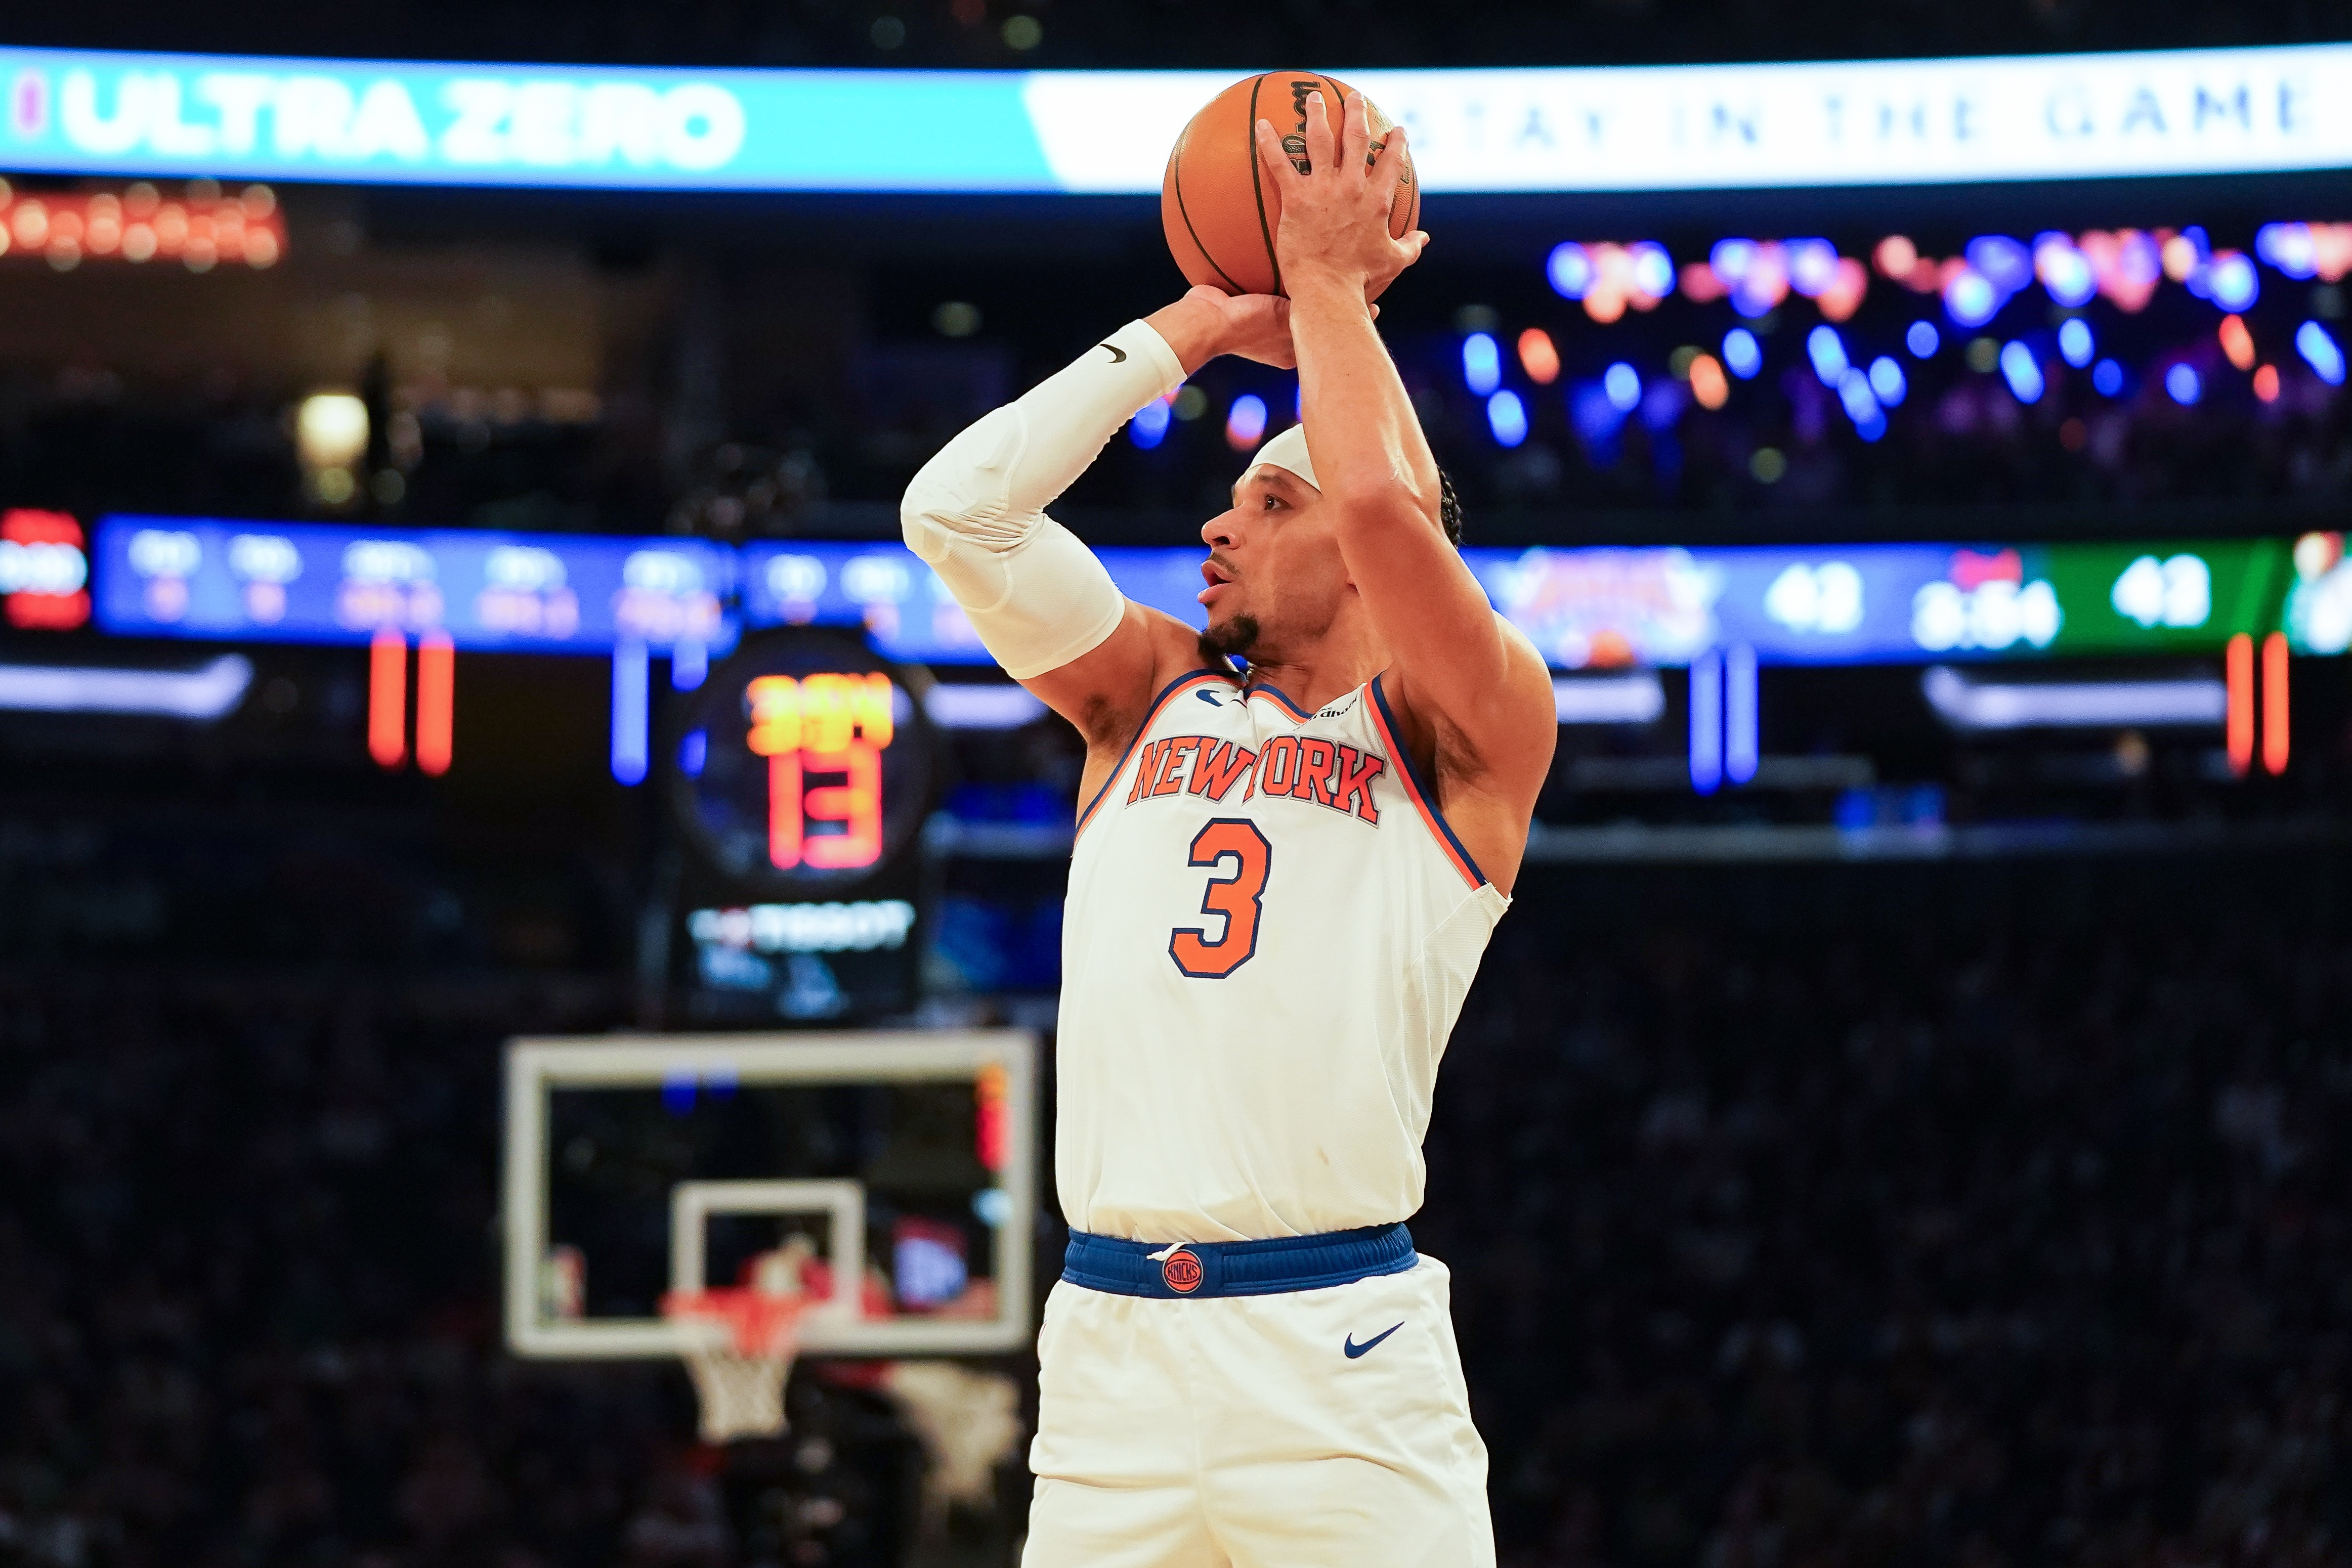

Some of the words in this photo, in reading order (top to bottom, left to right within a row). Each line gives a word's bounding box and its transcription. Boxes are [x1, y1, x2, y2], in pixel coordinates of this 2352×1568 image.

[60, 66, 433, 160] ULTRA
[438, 76, 749, 171] ZERO
[1402, 100, 1615, 153] STAY
[1670, 97, 1762, 152] IN
[1819, 92, 1988, 145] THE
[2045, 77, 2316, 139] GAME
[1126, 734, 1259, 809] NEW
[1242, 733, 1386, 829] YORK
[1168, 817, 1272, 979] 3
[1167, 1262, 1198, 1282] KNICKS
